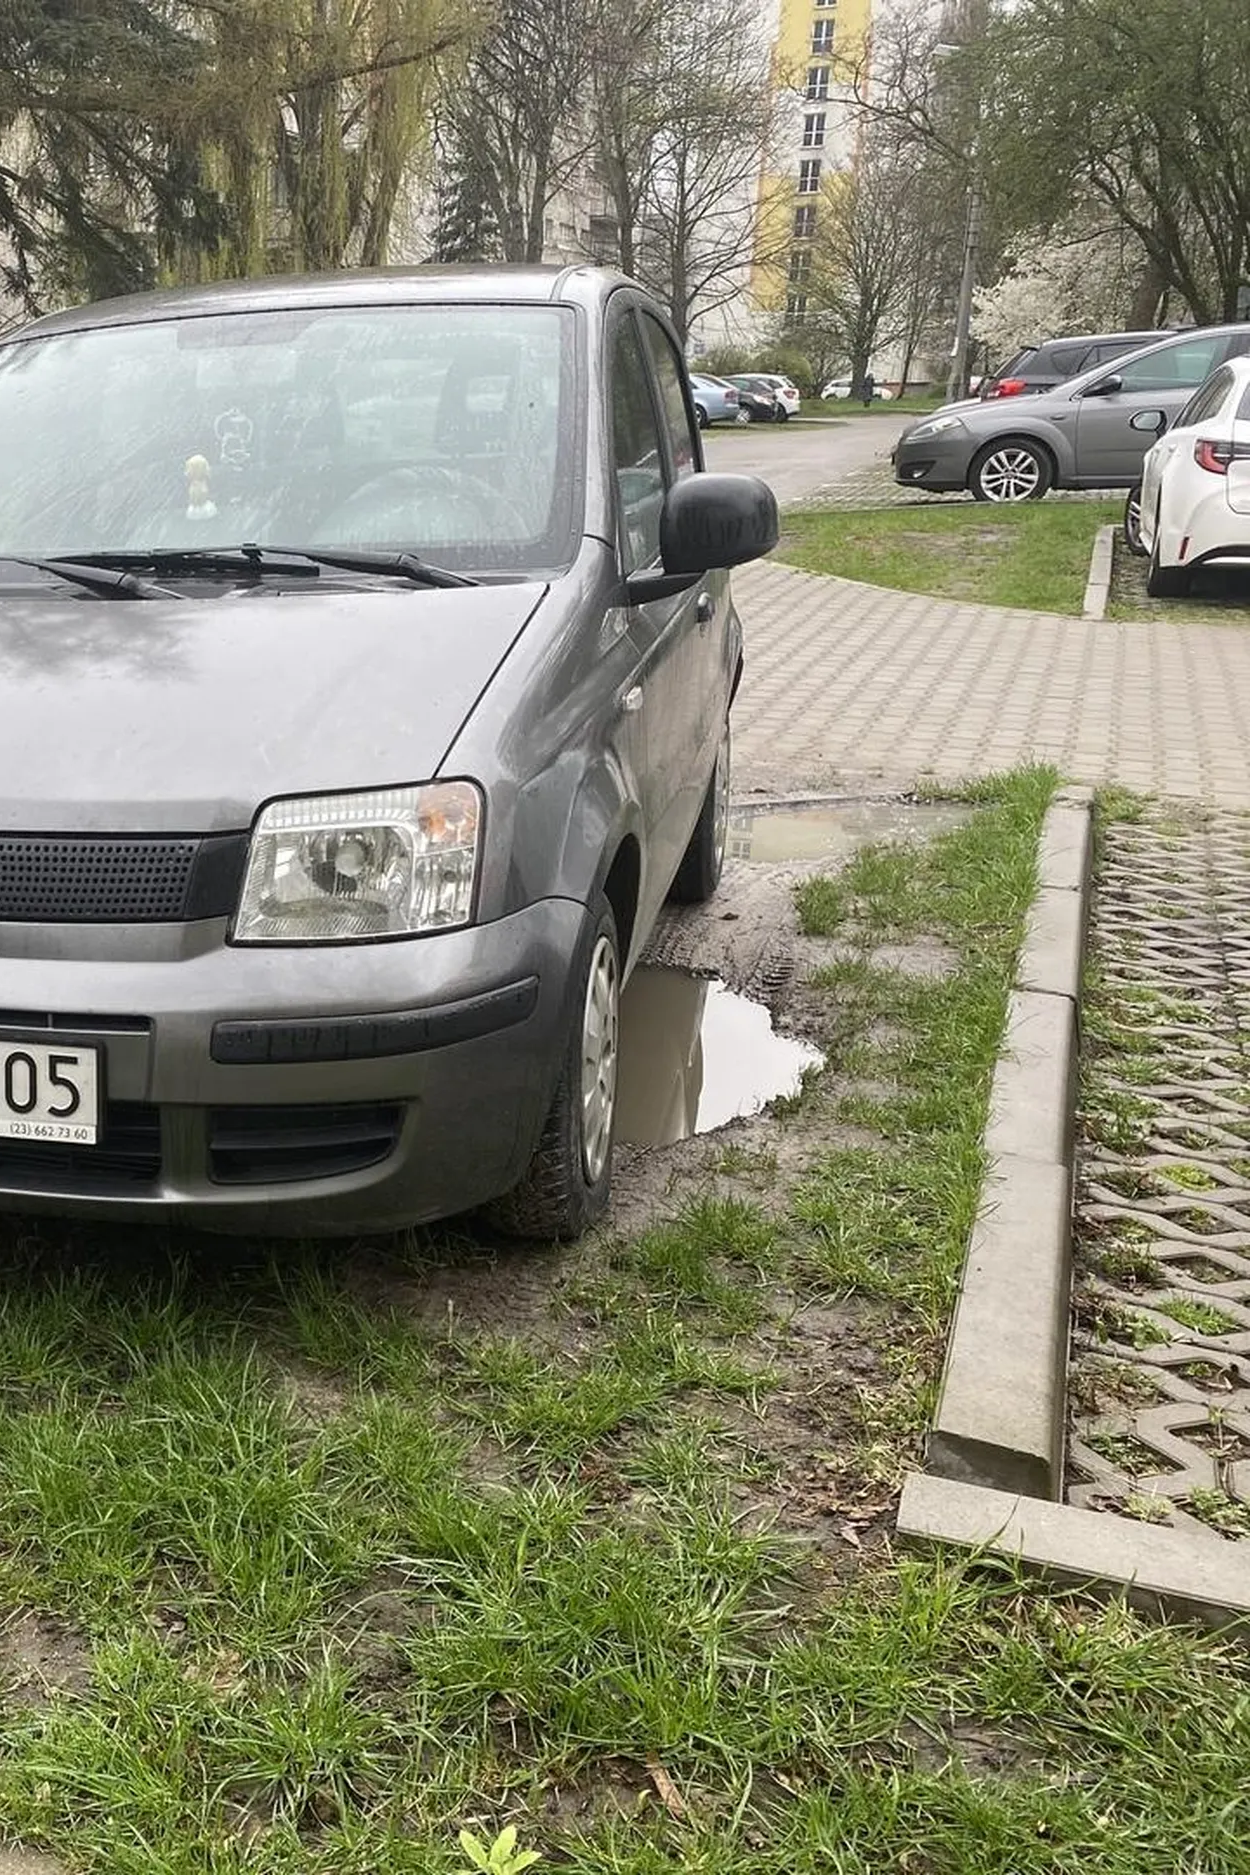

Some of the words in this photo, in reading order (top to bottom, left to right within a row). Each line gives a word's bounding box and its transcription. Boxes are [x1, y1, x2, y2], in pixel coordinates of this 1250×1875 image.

[10, 1122, 31, 1136] (23)
[34, 1125, 54, 1138] 662
[58, 1129, 71, 1139] 73
[74, 1130, 88, 1140] 60
